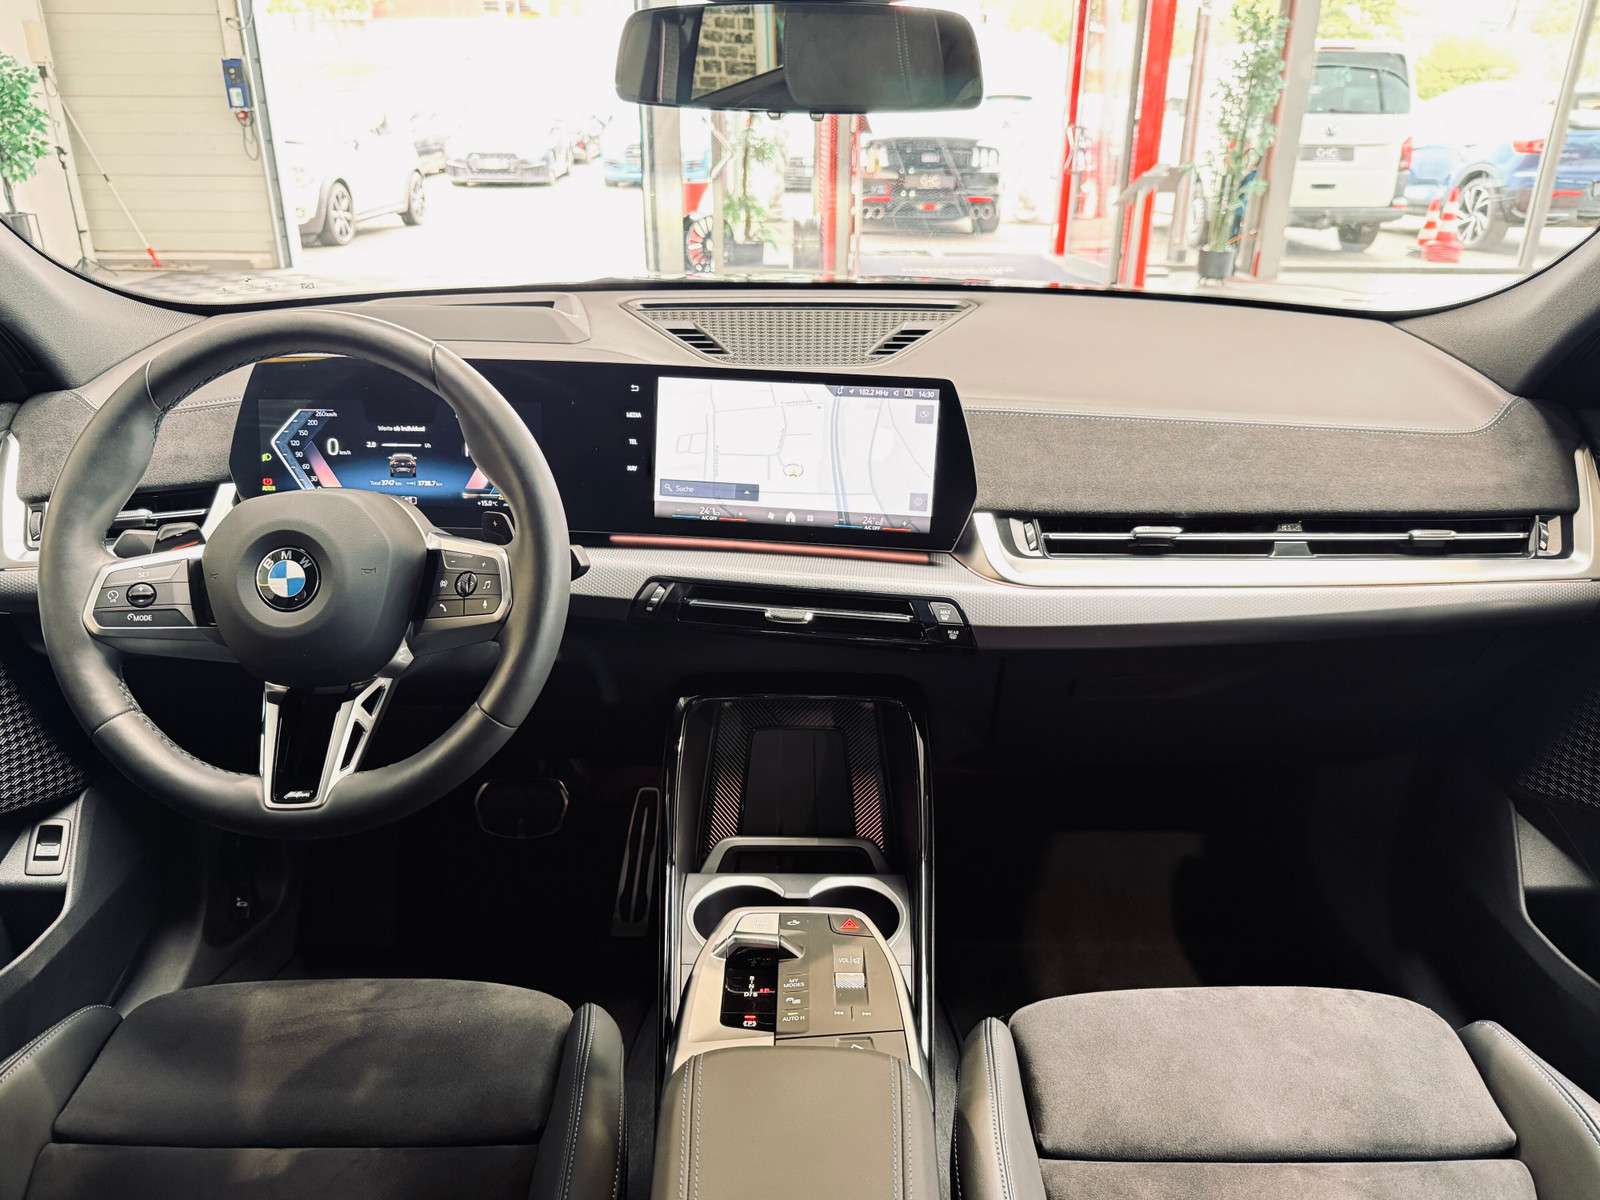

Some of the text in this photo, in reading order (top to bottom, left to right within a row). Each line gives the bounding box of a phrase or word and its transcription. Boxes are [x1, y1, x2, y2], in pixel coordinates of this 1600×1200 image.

[326, 437, 339, 456] 0
[676, 485, 694, 494] Suche
[262, 550, 312, 570] BMW
